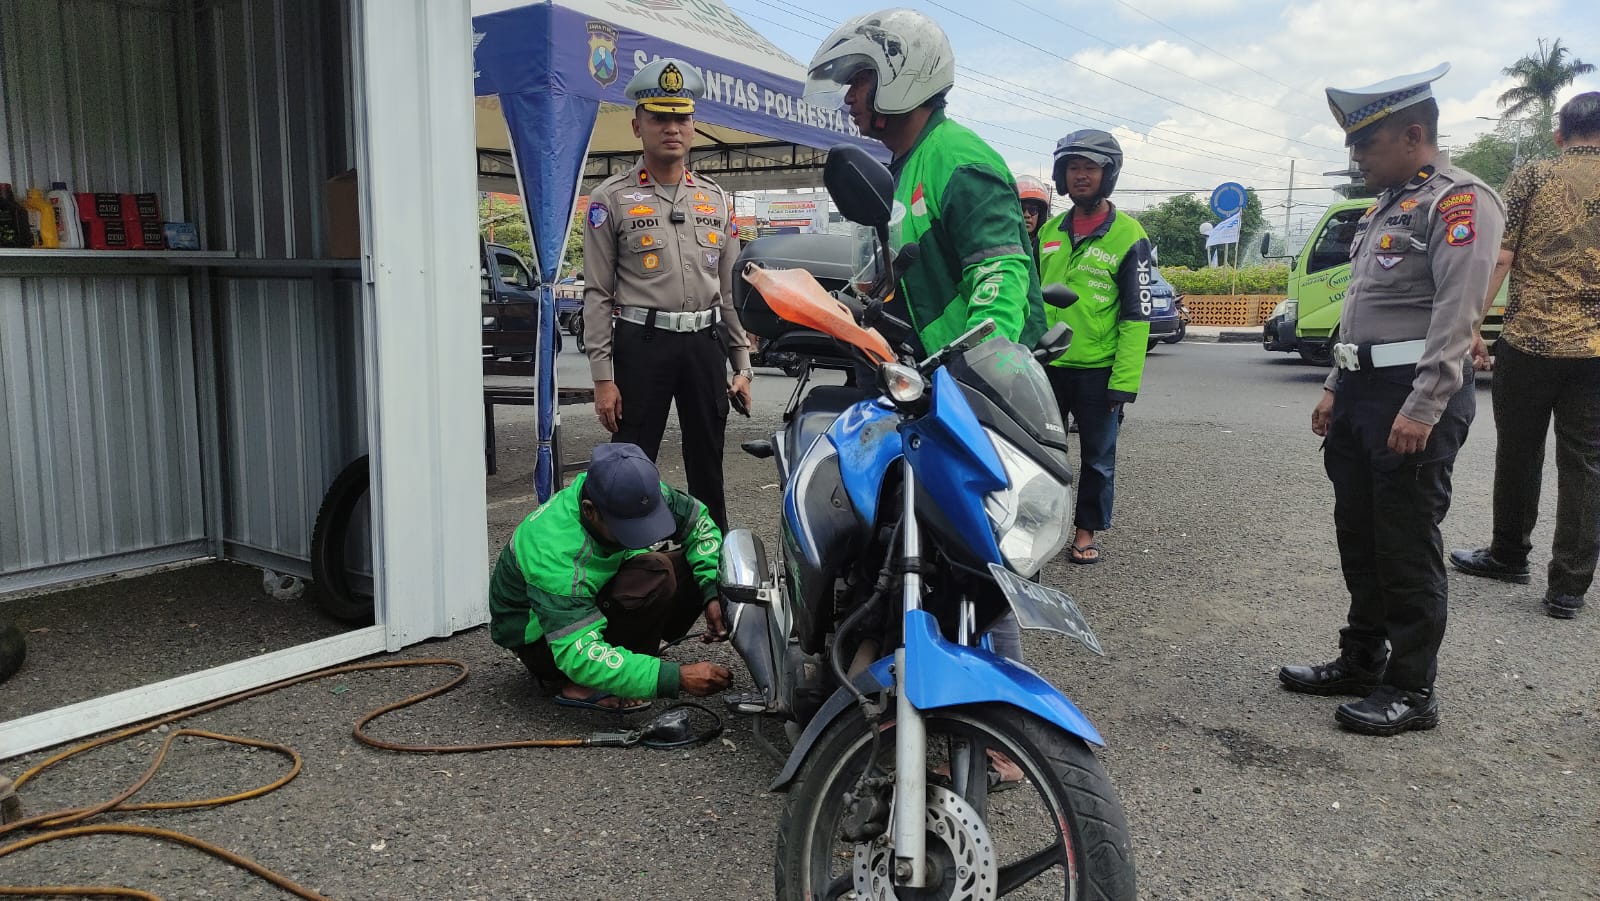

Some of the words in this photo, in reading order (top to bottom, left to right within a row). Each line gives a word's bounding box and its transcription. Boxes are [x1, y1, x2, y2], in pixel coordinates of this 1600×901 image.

[764, 88, 845, 134] POLRESTA
[631, 218, 659, 230] JODI
[696, 217, 721, 228] POLRI
[1384, 214, 1412, 226] POLRI
[1084, 246, 1119, 267] gojek
[1088, 280, 1112, 291] gopay
